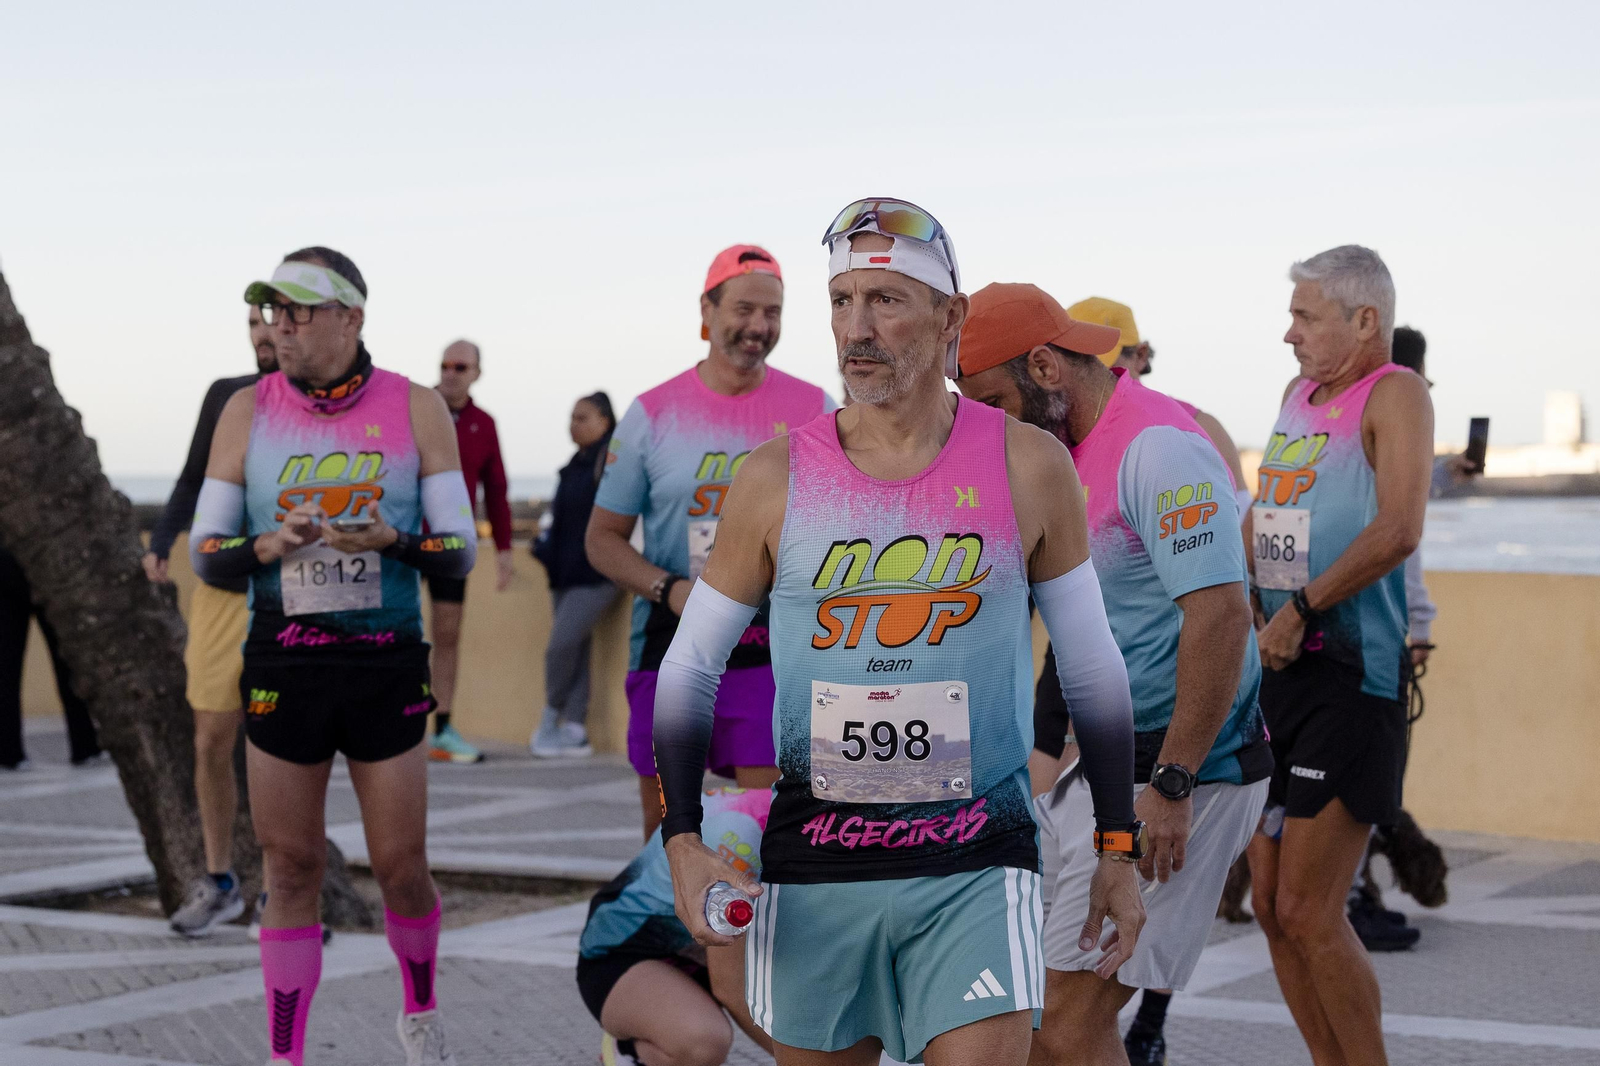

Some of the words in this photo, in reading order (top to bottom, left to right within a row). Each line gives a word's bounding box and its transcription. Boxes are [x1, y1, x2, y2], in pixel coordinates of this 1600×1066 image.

[277, 451, 384, 485] non
[1157, 482, 1213, 514] non
[1159, 502, 1218, 539] STOP
[1172, 531, 1214, 555] team
[294, 557, 367, 587] 1812
[812, 533, 984, 590] non
[811, 592, 983, 650] STOP
[866, 656, 913, 673] team
[841, 719, 931, 762] 598
[801, 798, 988, 850] ALGECIRAS
